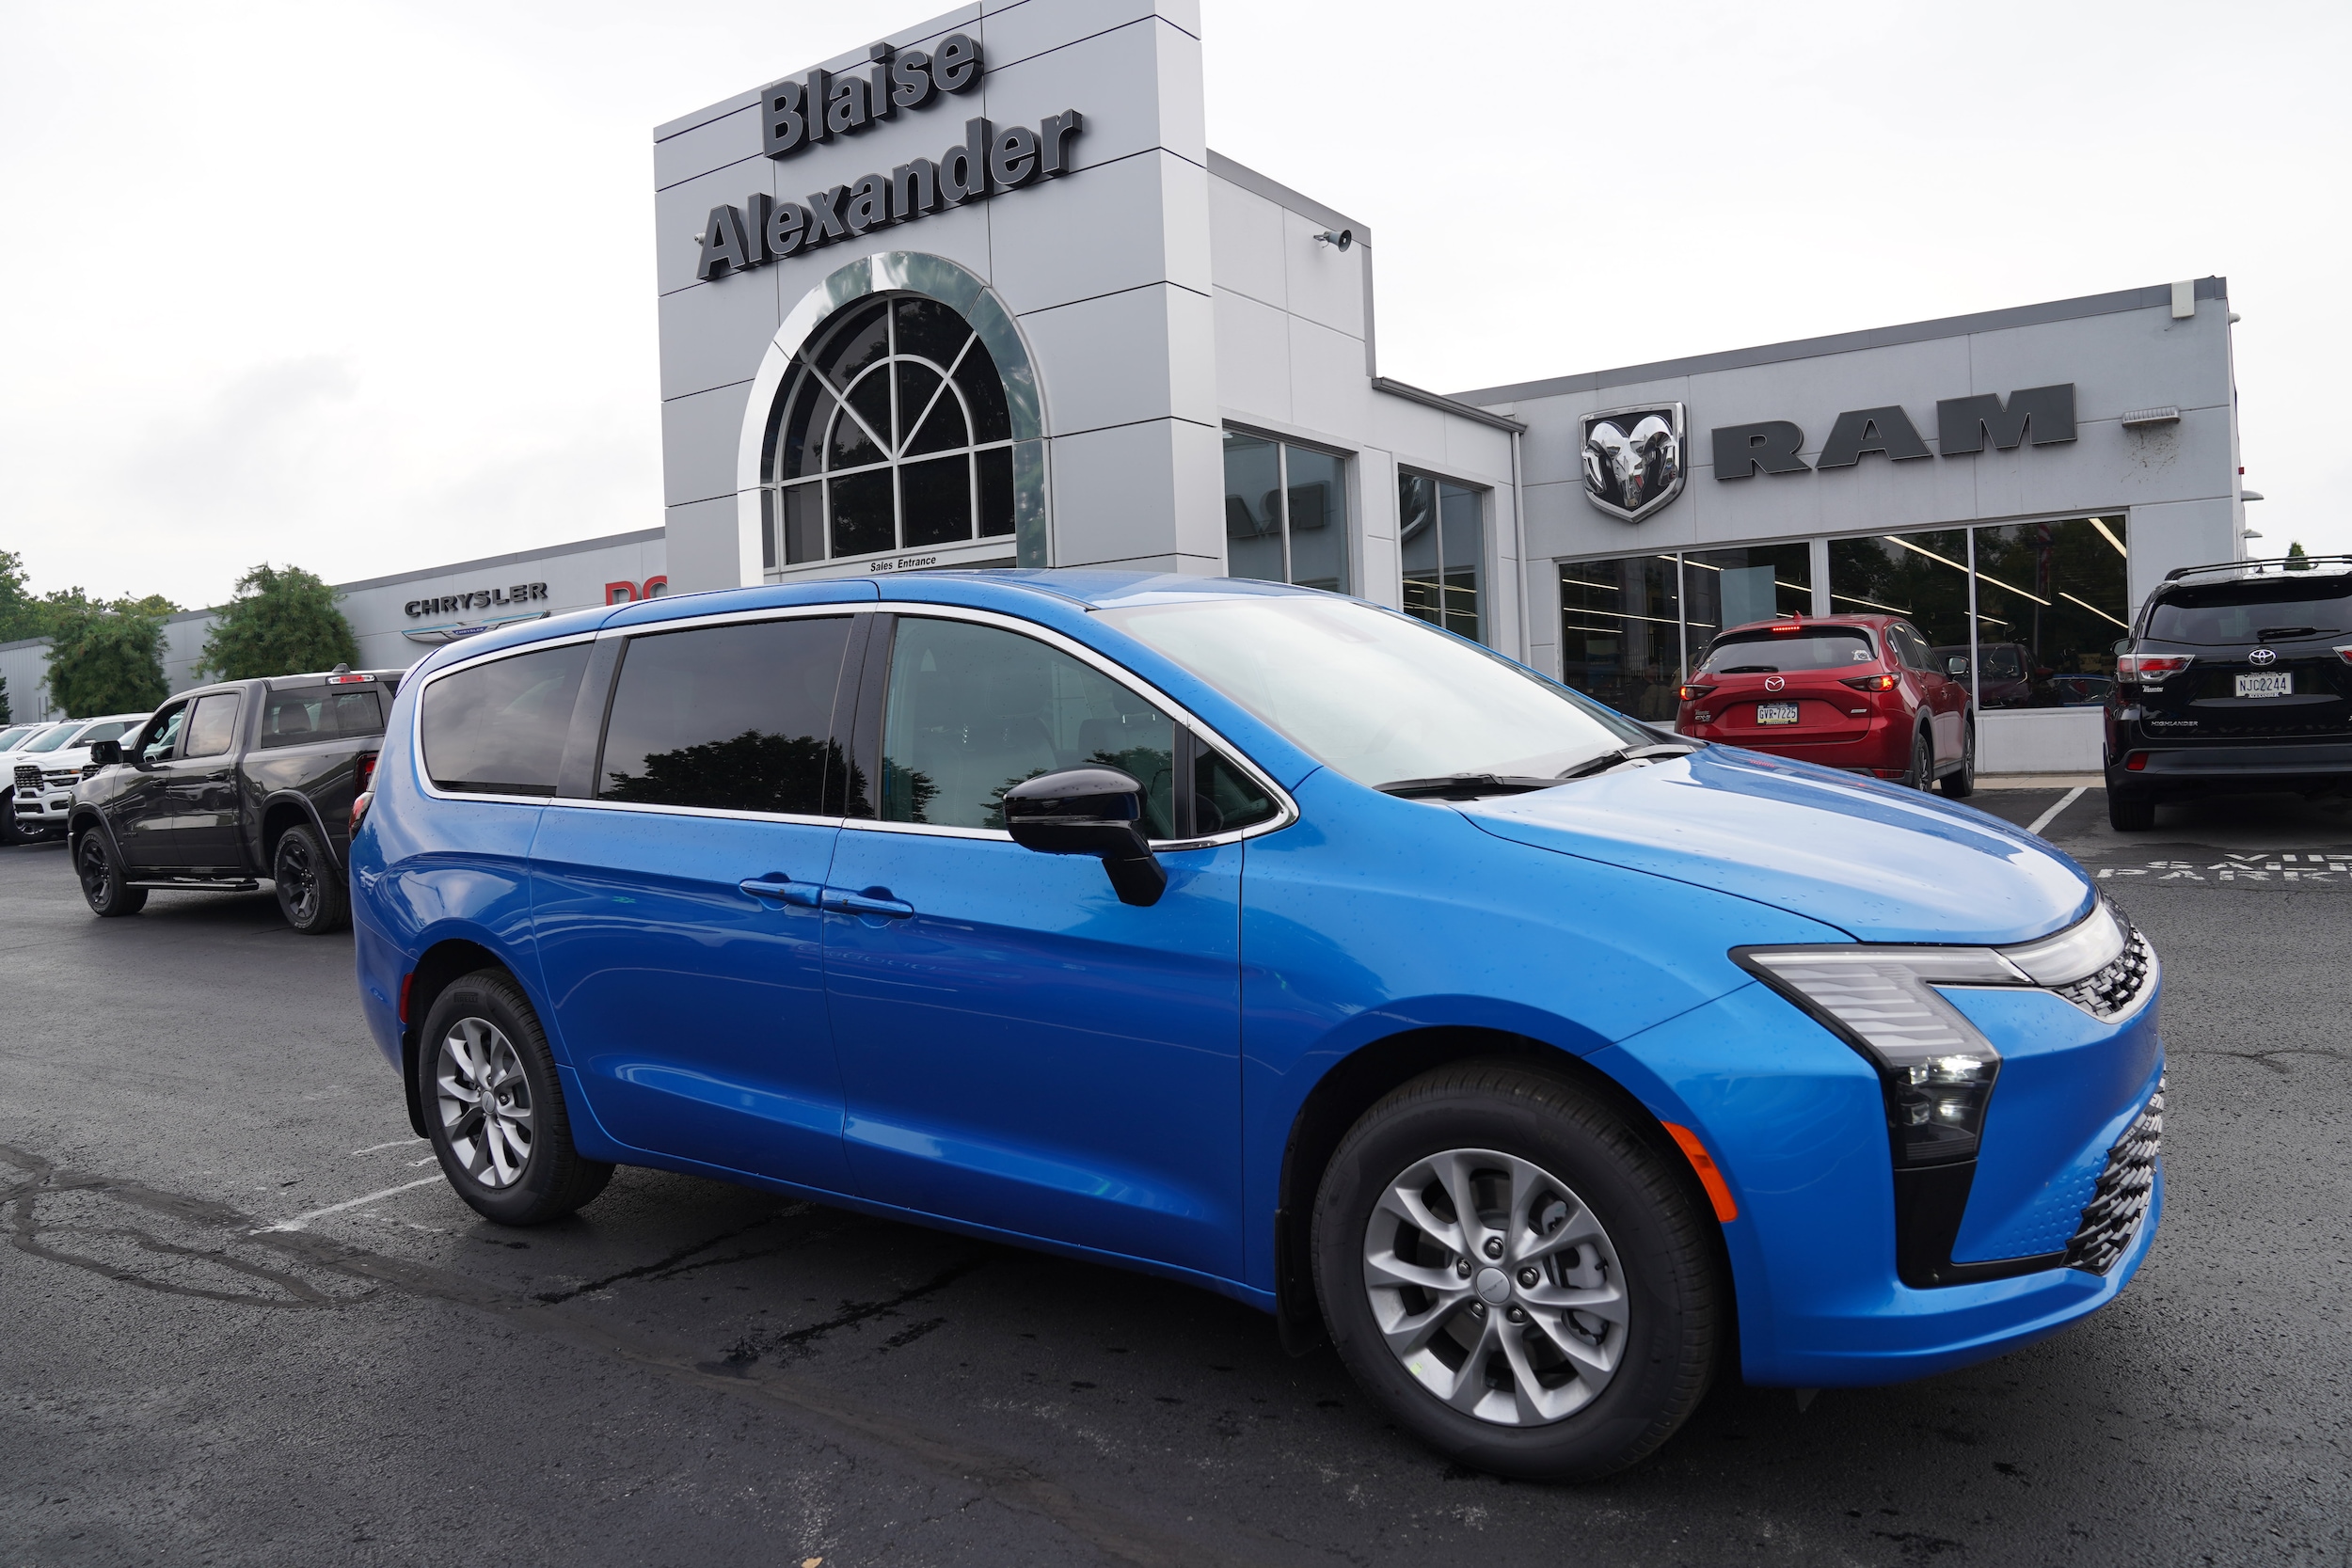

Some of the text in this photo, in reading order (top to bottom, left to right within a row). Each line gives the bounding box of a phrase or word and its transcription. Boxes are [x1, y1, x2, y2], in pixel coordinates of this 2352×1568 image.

[761, 33, 984, 160] Blaise
[697, 109, 1083, 280] Alexander
[1711, 382, 2077, 480] RAM
[870, 557, 936, 572] Sales Entrance
[405, 582, 548, 617] CHRYSLER
[2239, 677, 2286, 691] NJC2244
[2097, 869, 2352, 881] PARK
